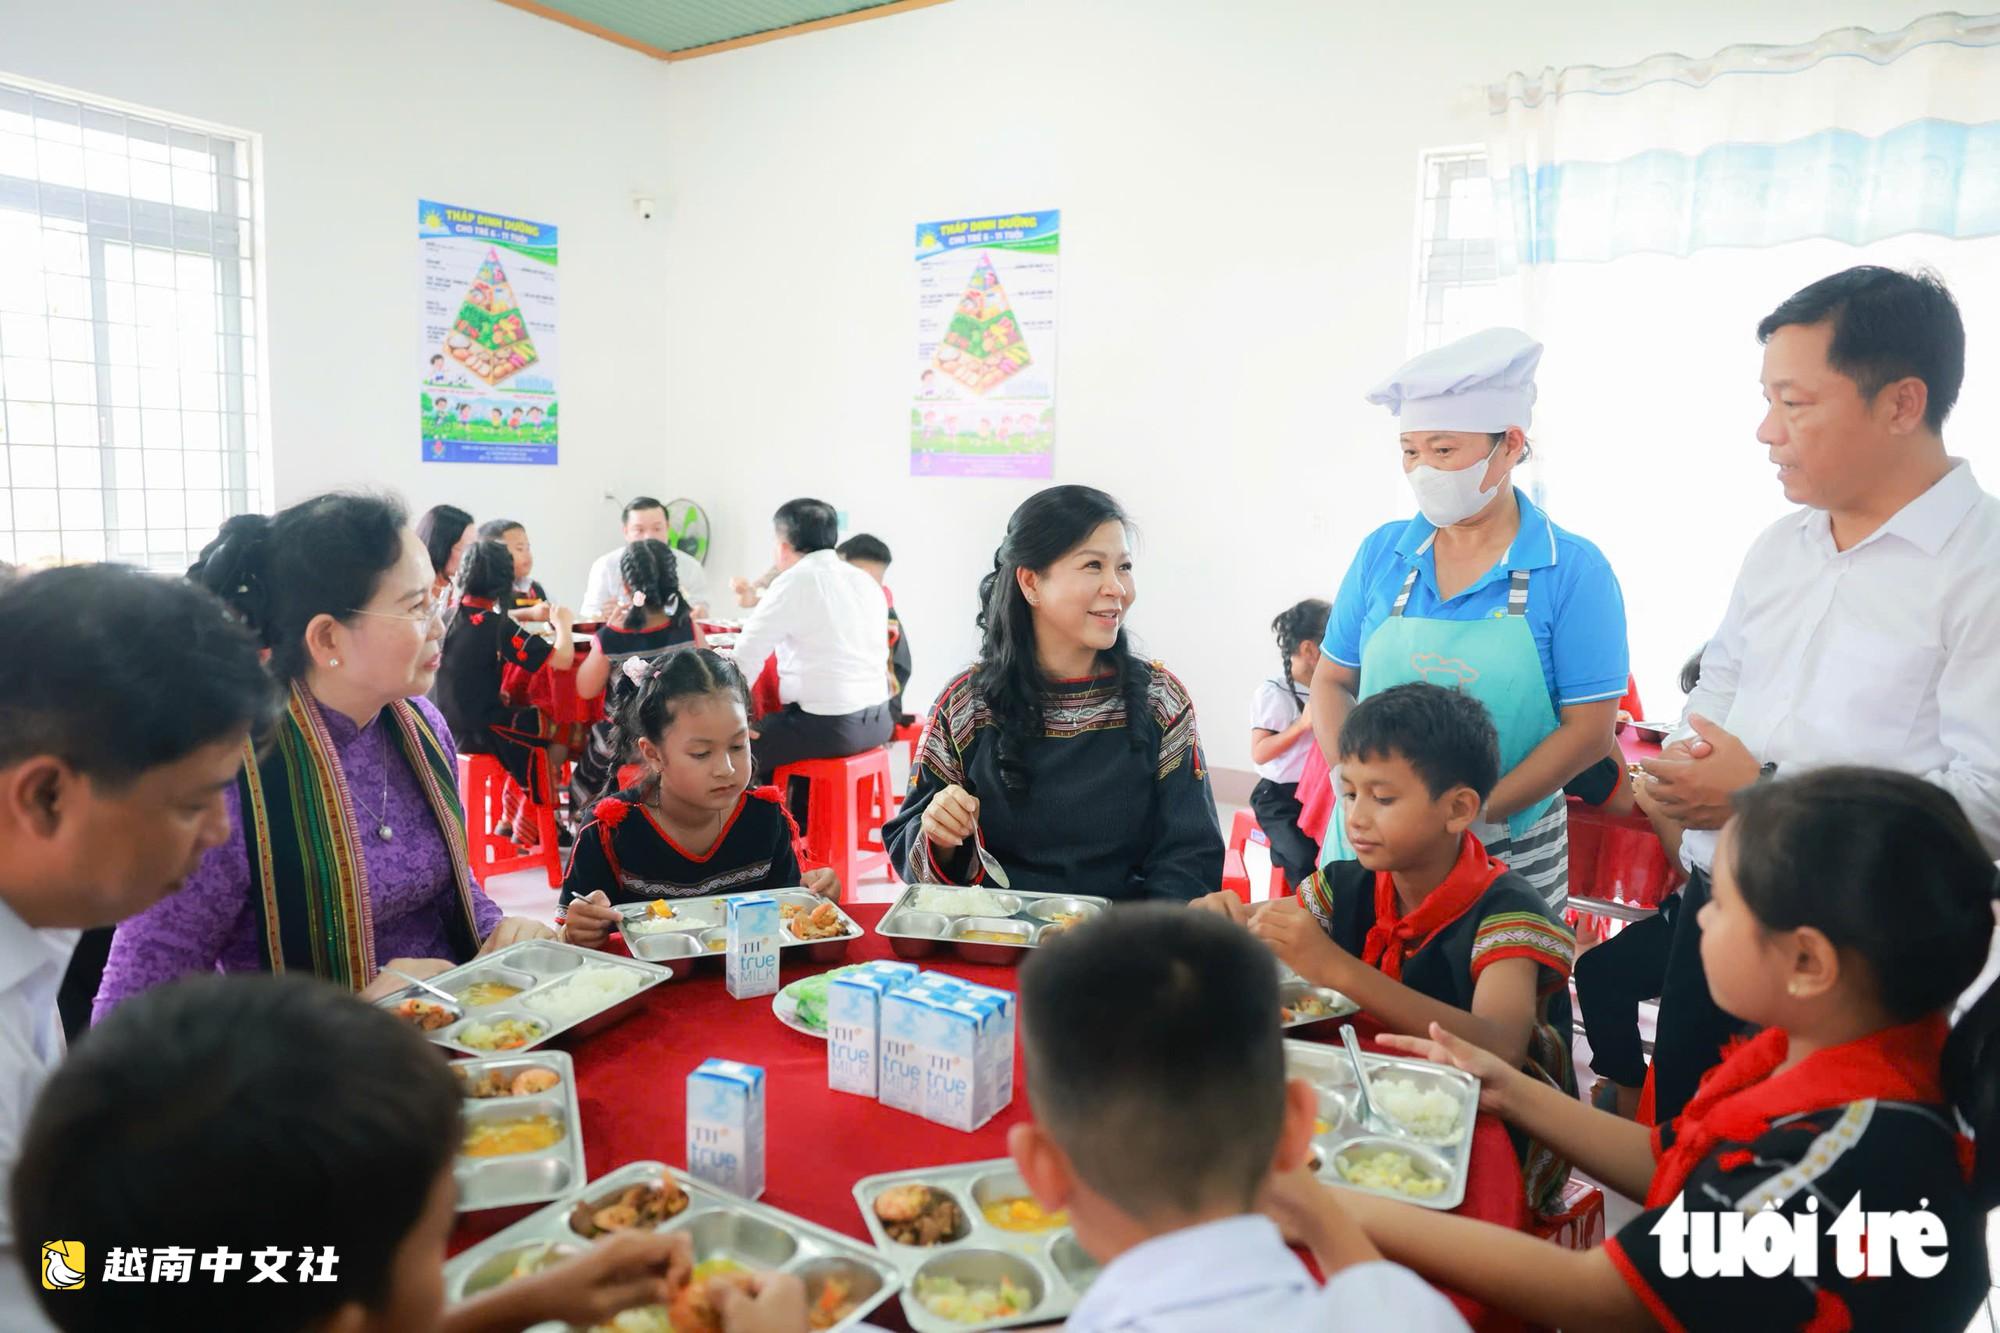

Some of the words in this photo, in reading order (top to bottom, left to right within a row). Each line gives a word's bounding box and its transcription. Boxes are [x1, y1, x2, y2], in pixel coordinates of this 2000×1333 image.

[741, 941, 760, 954] TH
[740, 954, 776, 970] true
[740, 968, 775, 984] MILK
[832, 1026, 853, 1042] TH
[831, 1040, 870, 1064] true
[831, 1059, 869, 1079] MILK
[883, 1054, 921, 1079] true
[883, 1073, 921, 1097] MILK
[927, 1069, 968, 1096] true
[927, 1089, 968, 1112] MILK
[691, 1141, 737, 1168] true
